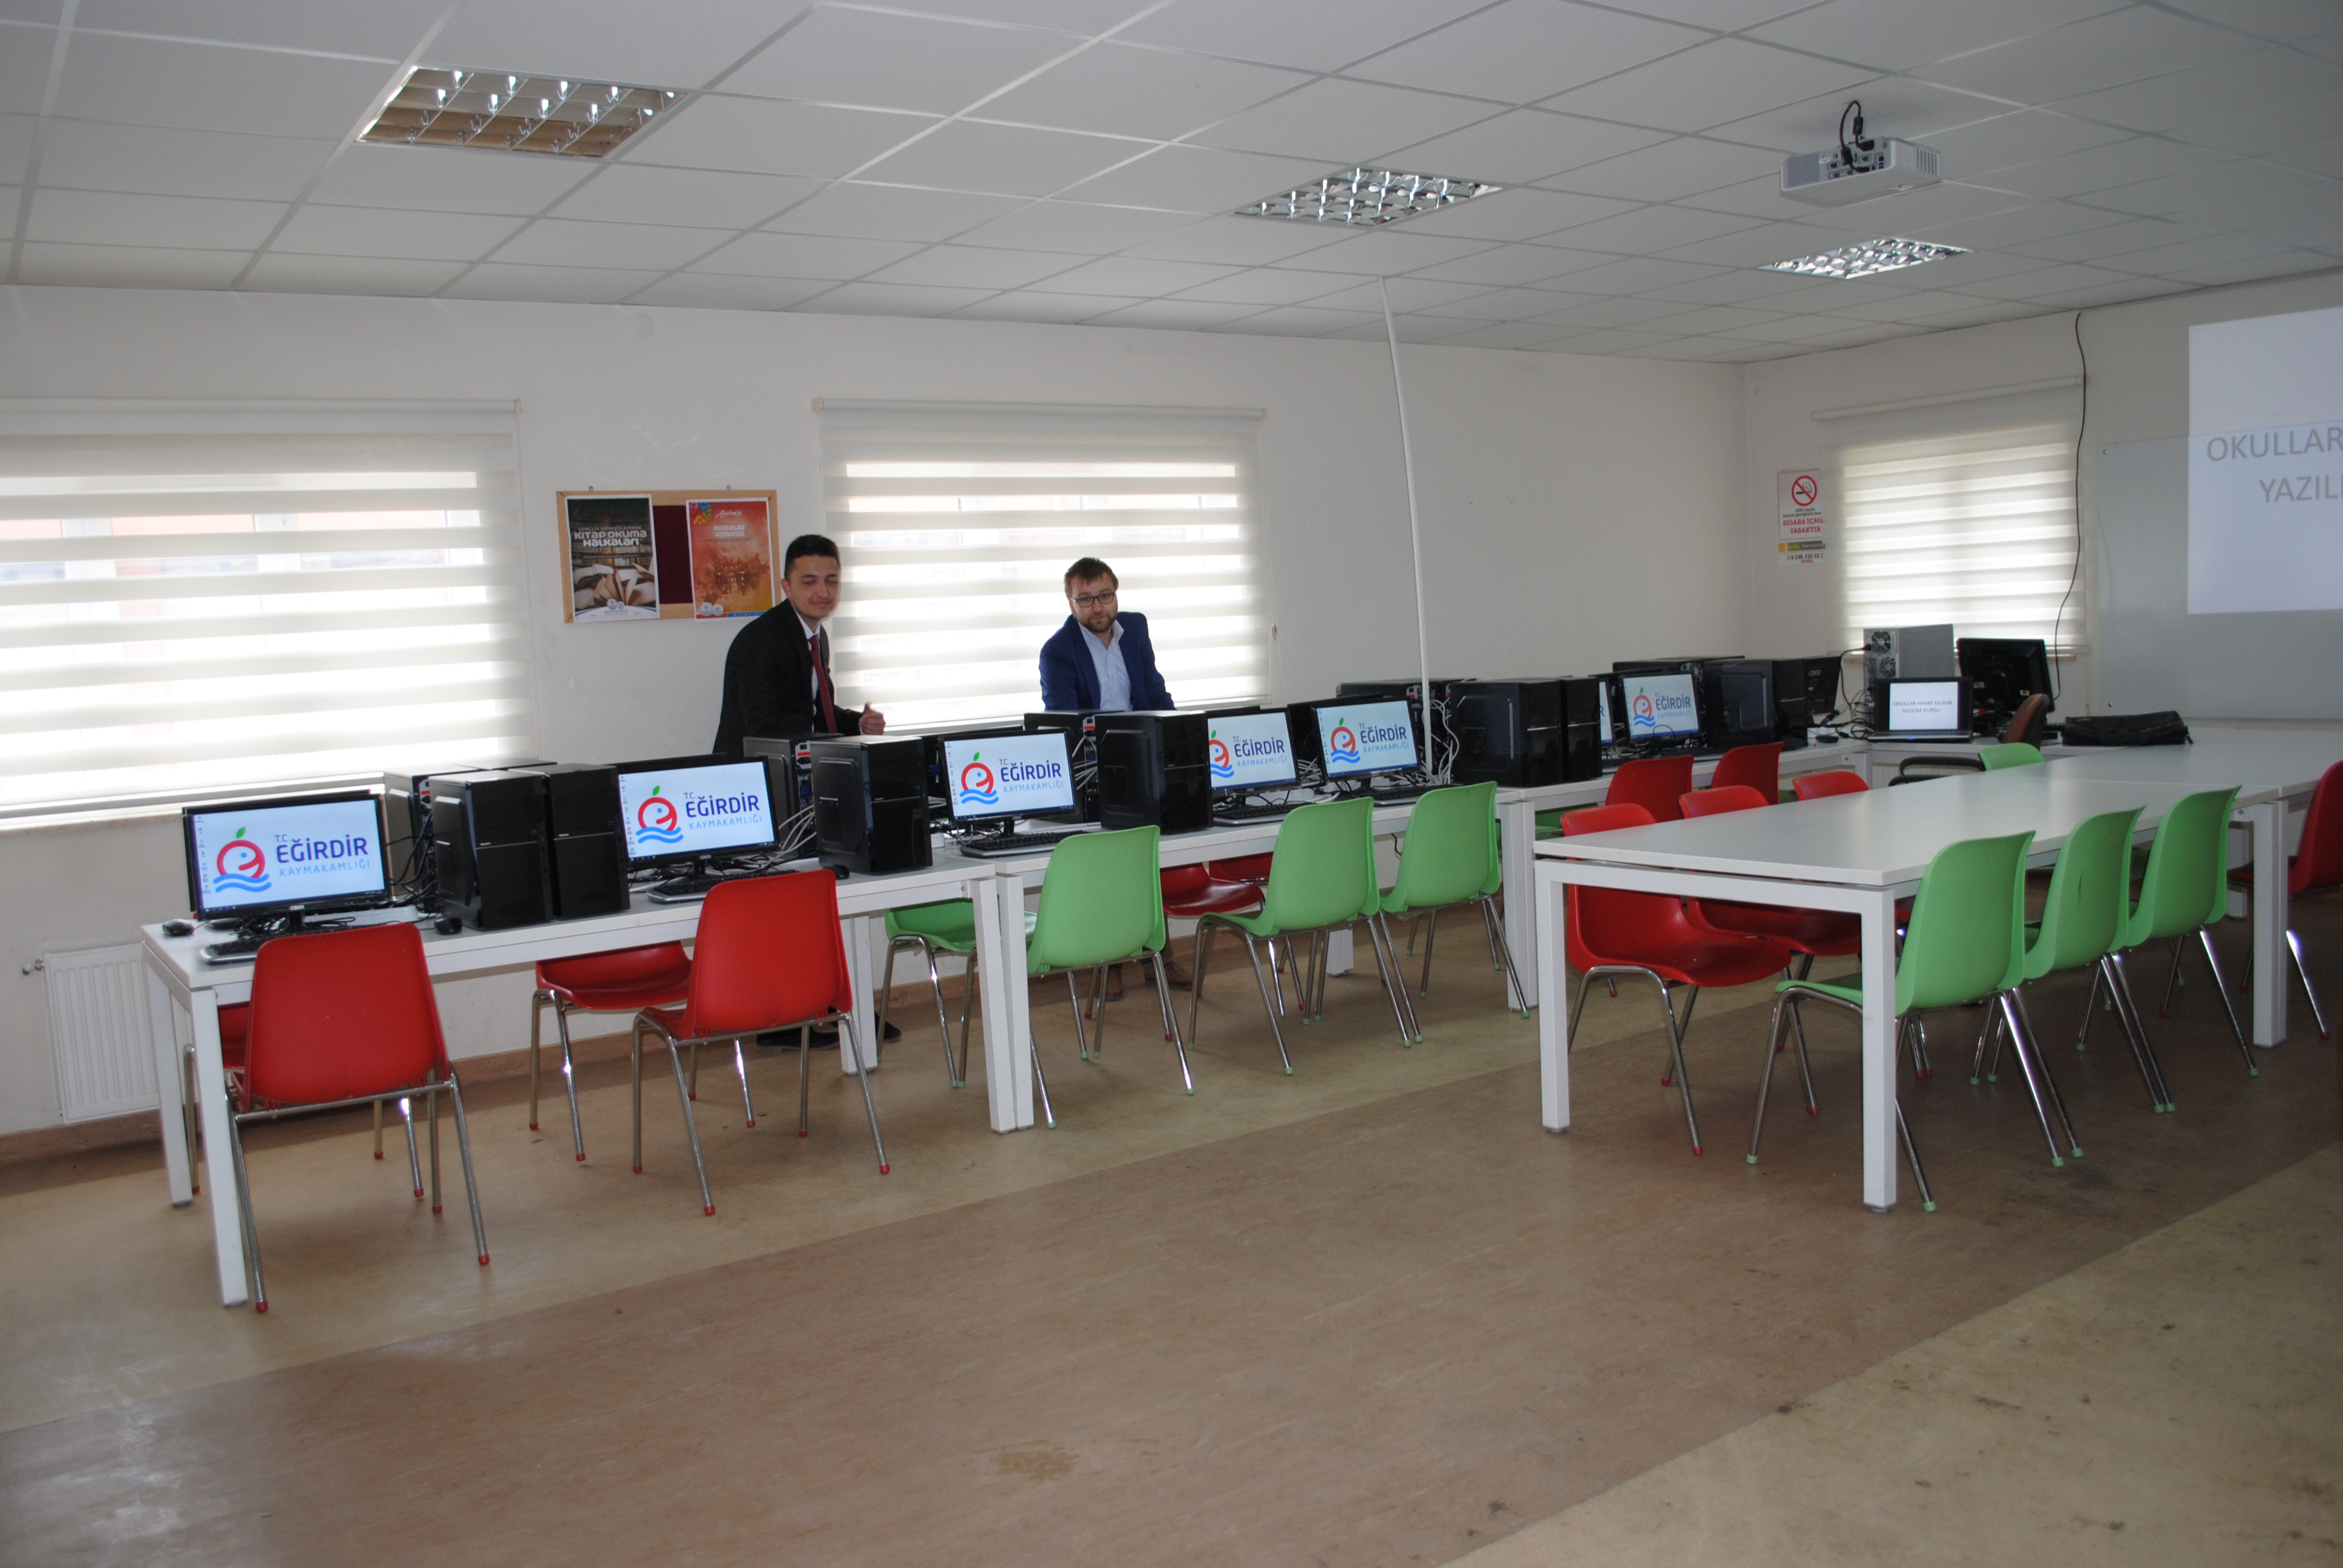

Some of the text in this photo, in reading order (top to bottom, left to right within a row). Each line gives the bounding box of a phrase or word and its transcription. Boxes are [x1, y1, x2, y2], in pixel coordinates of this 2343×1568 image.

[2206, 426, 2343, 462] OKULLAR
[1783, 518, 1806, 526] SİGARA
[1656, 694, 1691, 711] EĞİRDİR
[1360, 724, 1407, 743] EĞİRDİR
[1234, 737, 1285, 757] EĞİRDİR
[1363, 742, 1409, 753] KAYMAKAMLIĞI
[1000, 760, 1062, 782] EĞİRDİR
[1237, 756, 1287, 768] KAYMAKAMLIĞI
[1003, 780, 1064, 793] KAYMAKAMLIĞI
[686, 792, 761, 818] EĞİRDİR
[689, 814, 762, 830] KAYMAKAMLIĞI
[277, 834, 369, 863] EĞİRDİR
[280, 858, 370, 877] KAYMAKAMLIĞI
